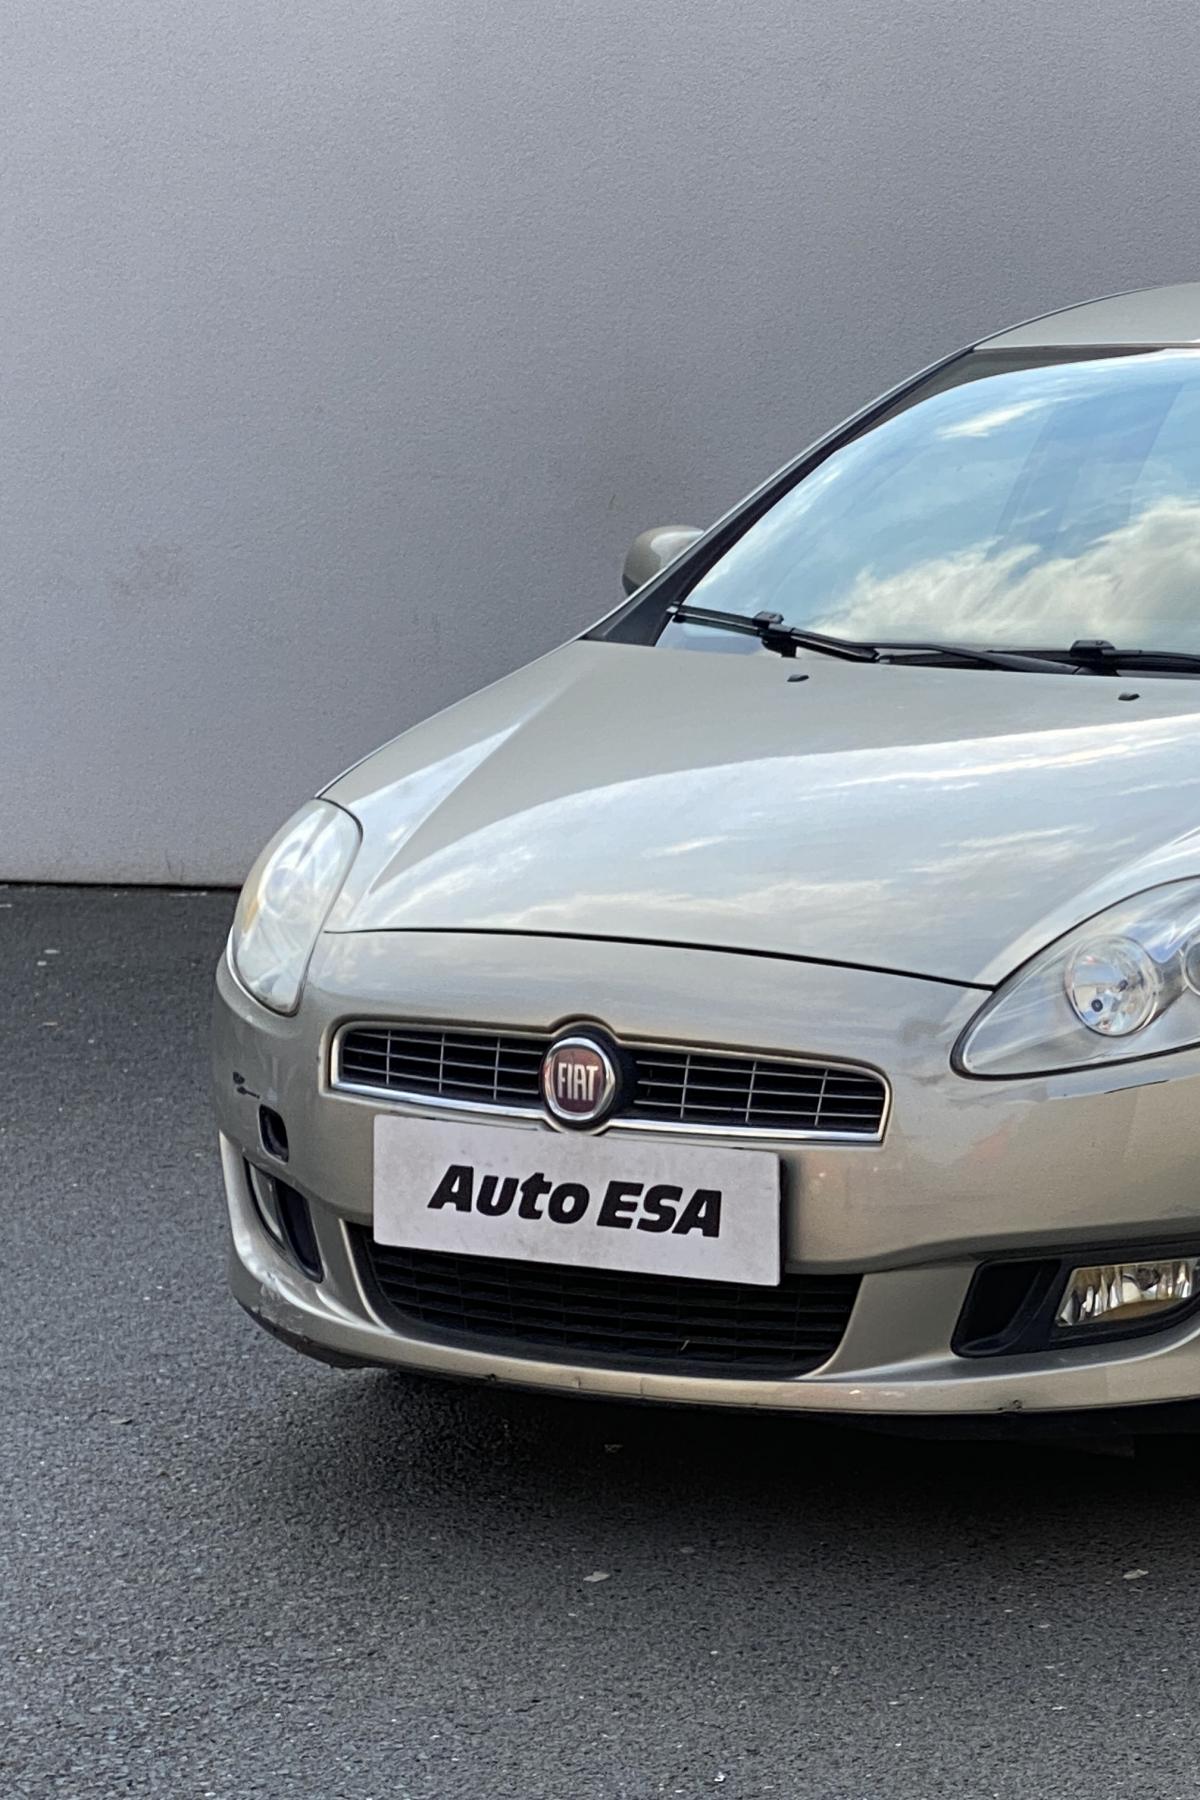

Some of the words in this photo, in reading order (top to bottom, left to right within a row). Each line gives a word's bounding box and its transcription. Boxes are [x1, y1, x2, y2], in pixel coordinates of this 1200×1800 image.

[558, 1063, 599, 1100] FIAT
[428, 1165, 590, 1224] Auto
[597, 1181, 722, 1238] ESA
